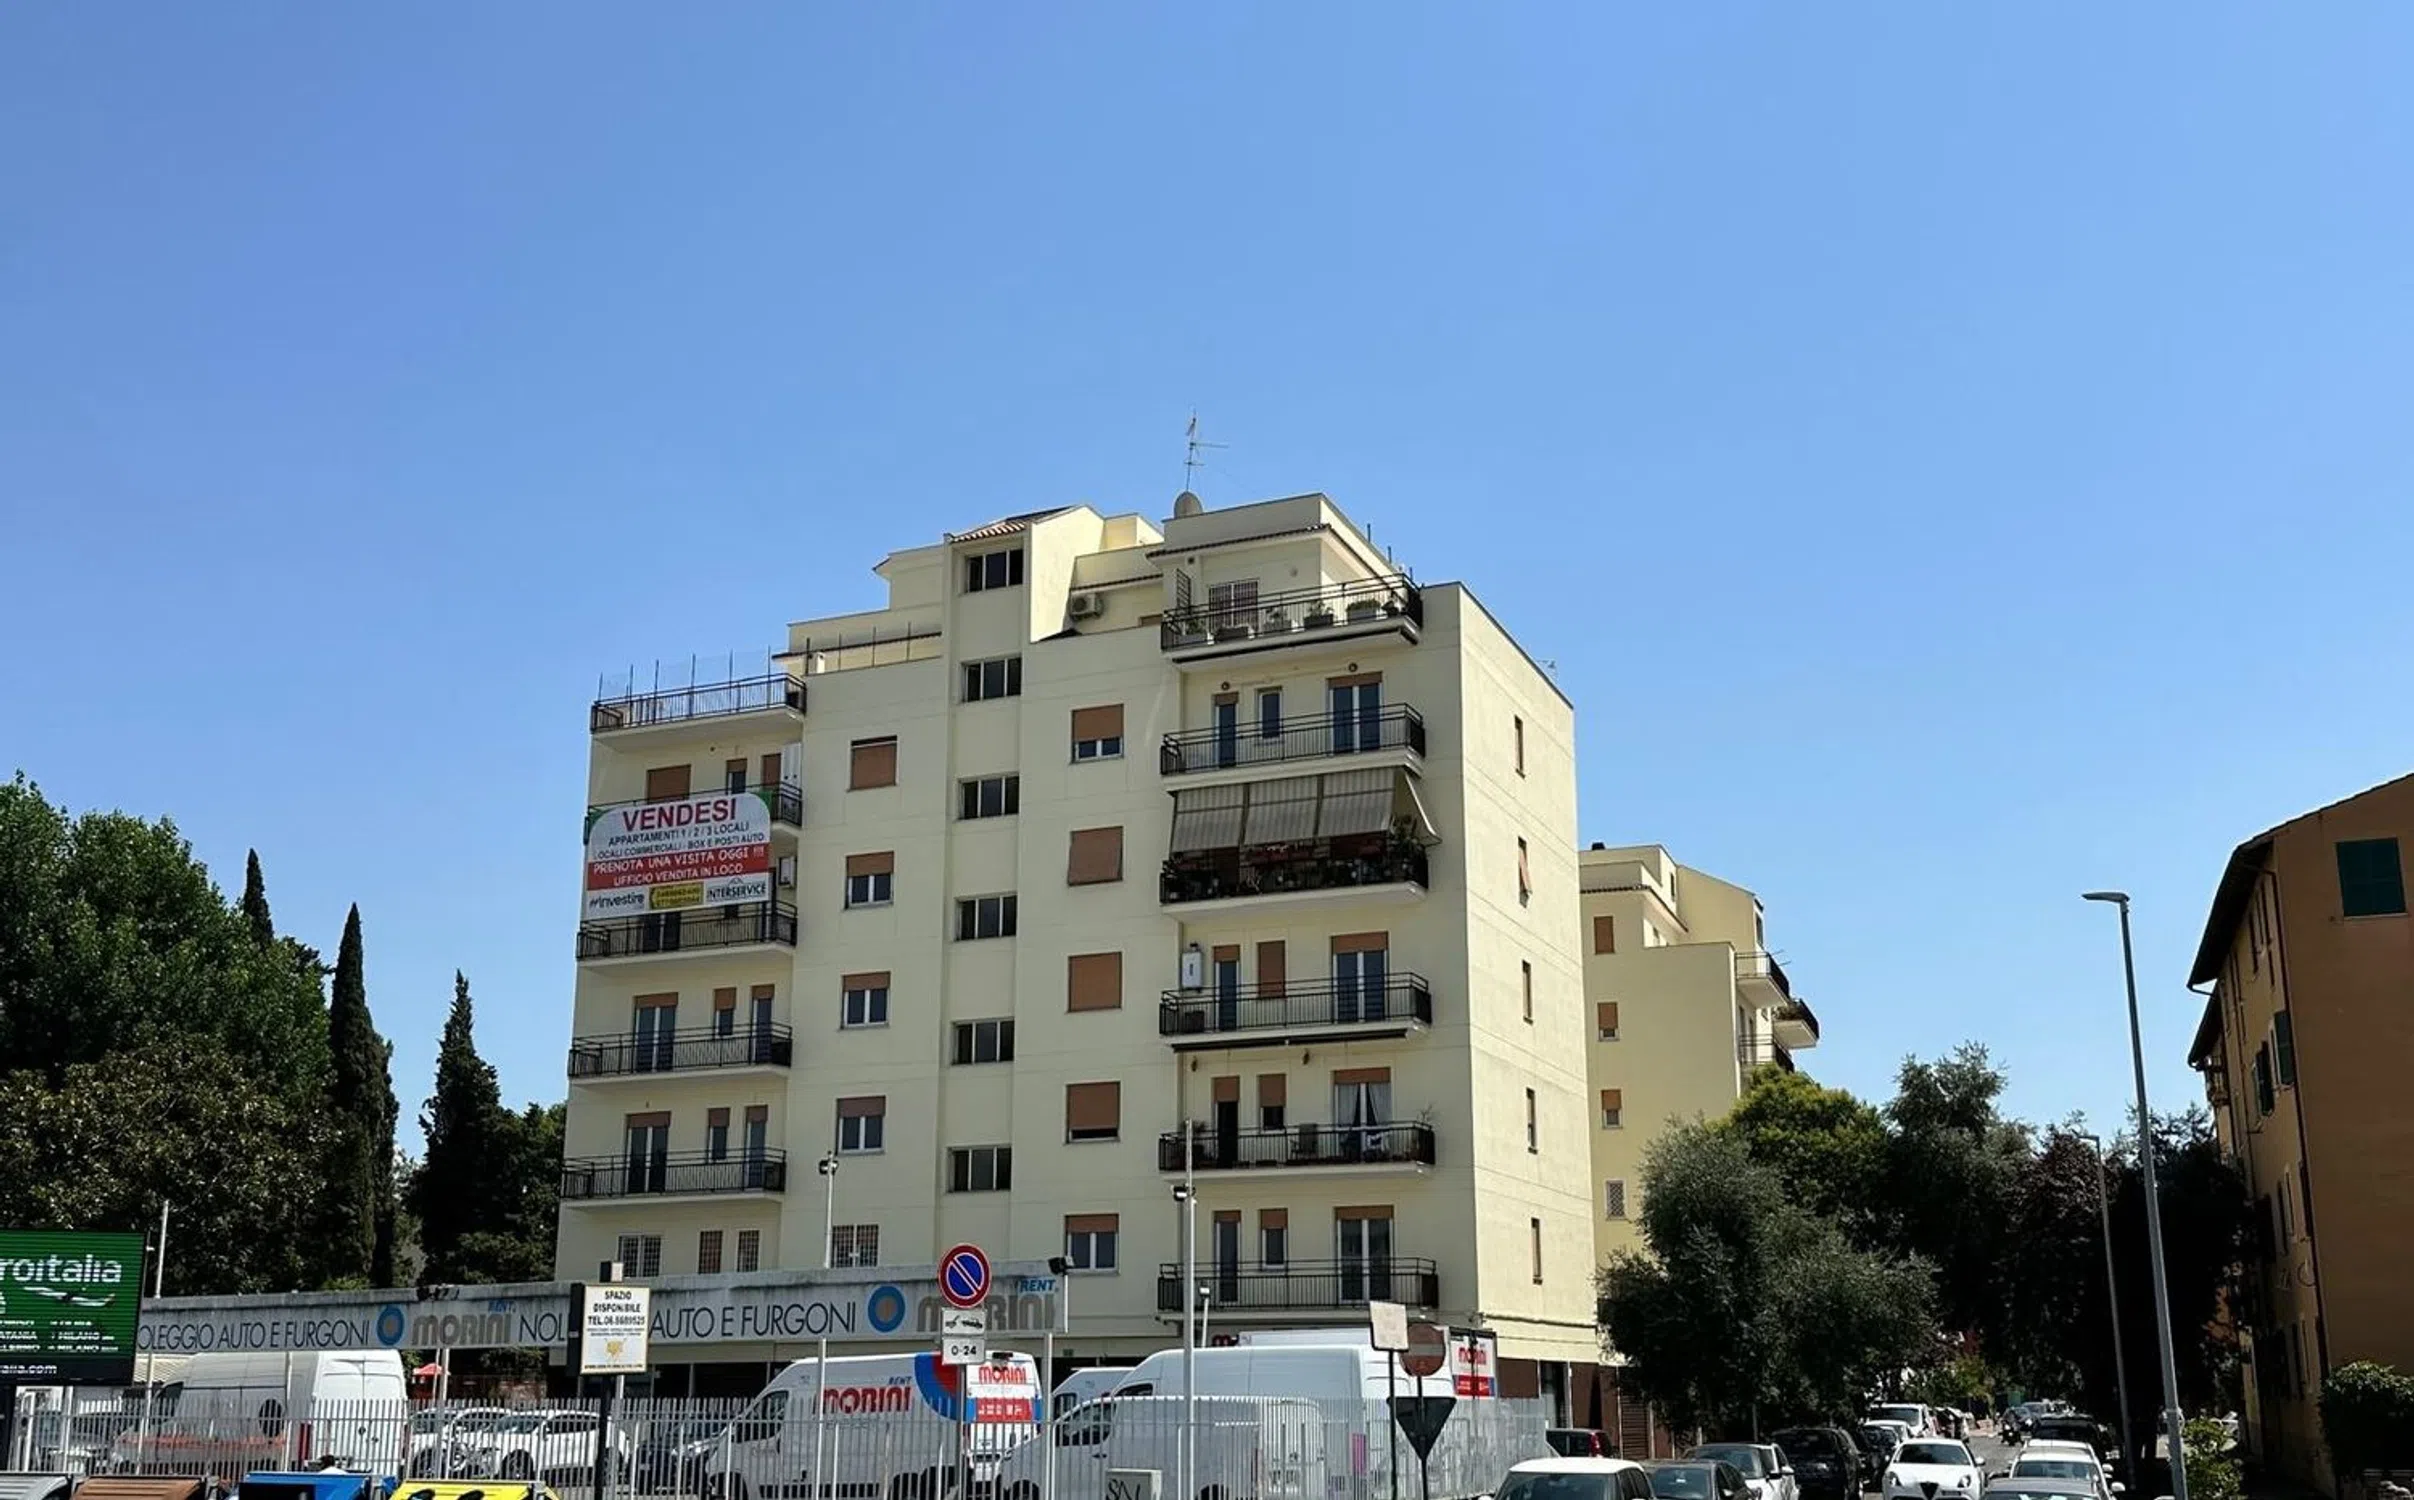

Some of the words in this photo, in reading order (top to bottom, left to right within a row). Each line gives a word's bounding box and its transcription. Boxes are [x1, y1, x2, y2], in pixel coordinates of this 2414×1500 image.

[623, 798, 737, 832] VENDESI
[608, 830, 679, 847] APPARTAMENTI
[714, 821, 749, 835] LOCALI
[688, 840, 706, 849] BOX
[741, 832, 764, 843] AUTO
[593, 859, 644, 875] PRENOTA
[648, 855, 671, 869] UNA
[674, 850, 714, 865] VISITA
[718, 846, 749, 861] OGGI
[613, 872, 653, 886] UFFICIO
[655, 867, 698, 882] VENDITA
[713, 863, 743, 876] LOCO
[593, 1303, 642, 1313] DISPONIBILE
[604, 1290, 632, 1300] SPAZIO
[138, 1323, 214, 1350] OLEGGIO
[216, 1321, 266, 1349] AUTO
[269, 1321, 280, 1348] E
[284, 1319, 370, 1348] FURGONI
[518, 1313, 567, 1343] NOL
[649, 1307, 715, 1339] AUTO
[721, 1306, 735, 1337] E
[741, 1302, 856, 1337] FURGONI
